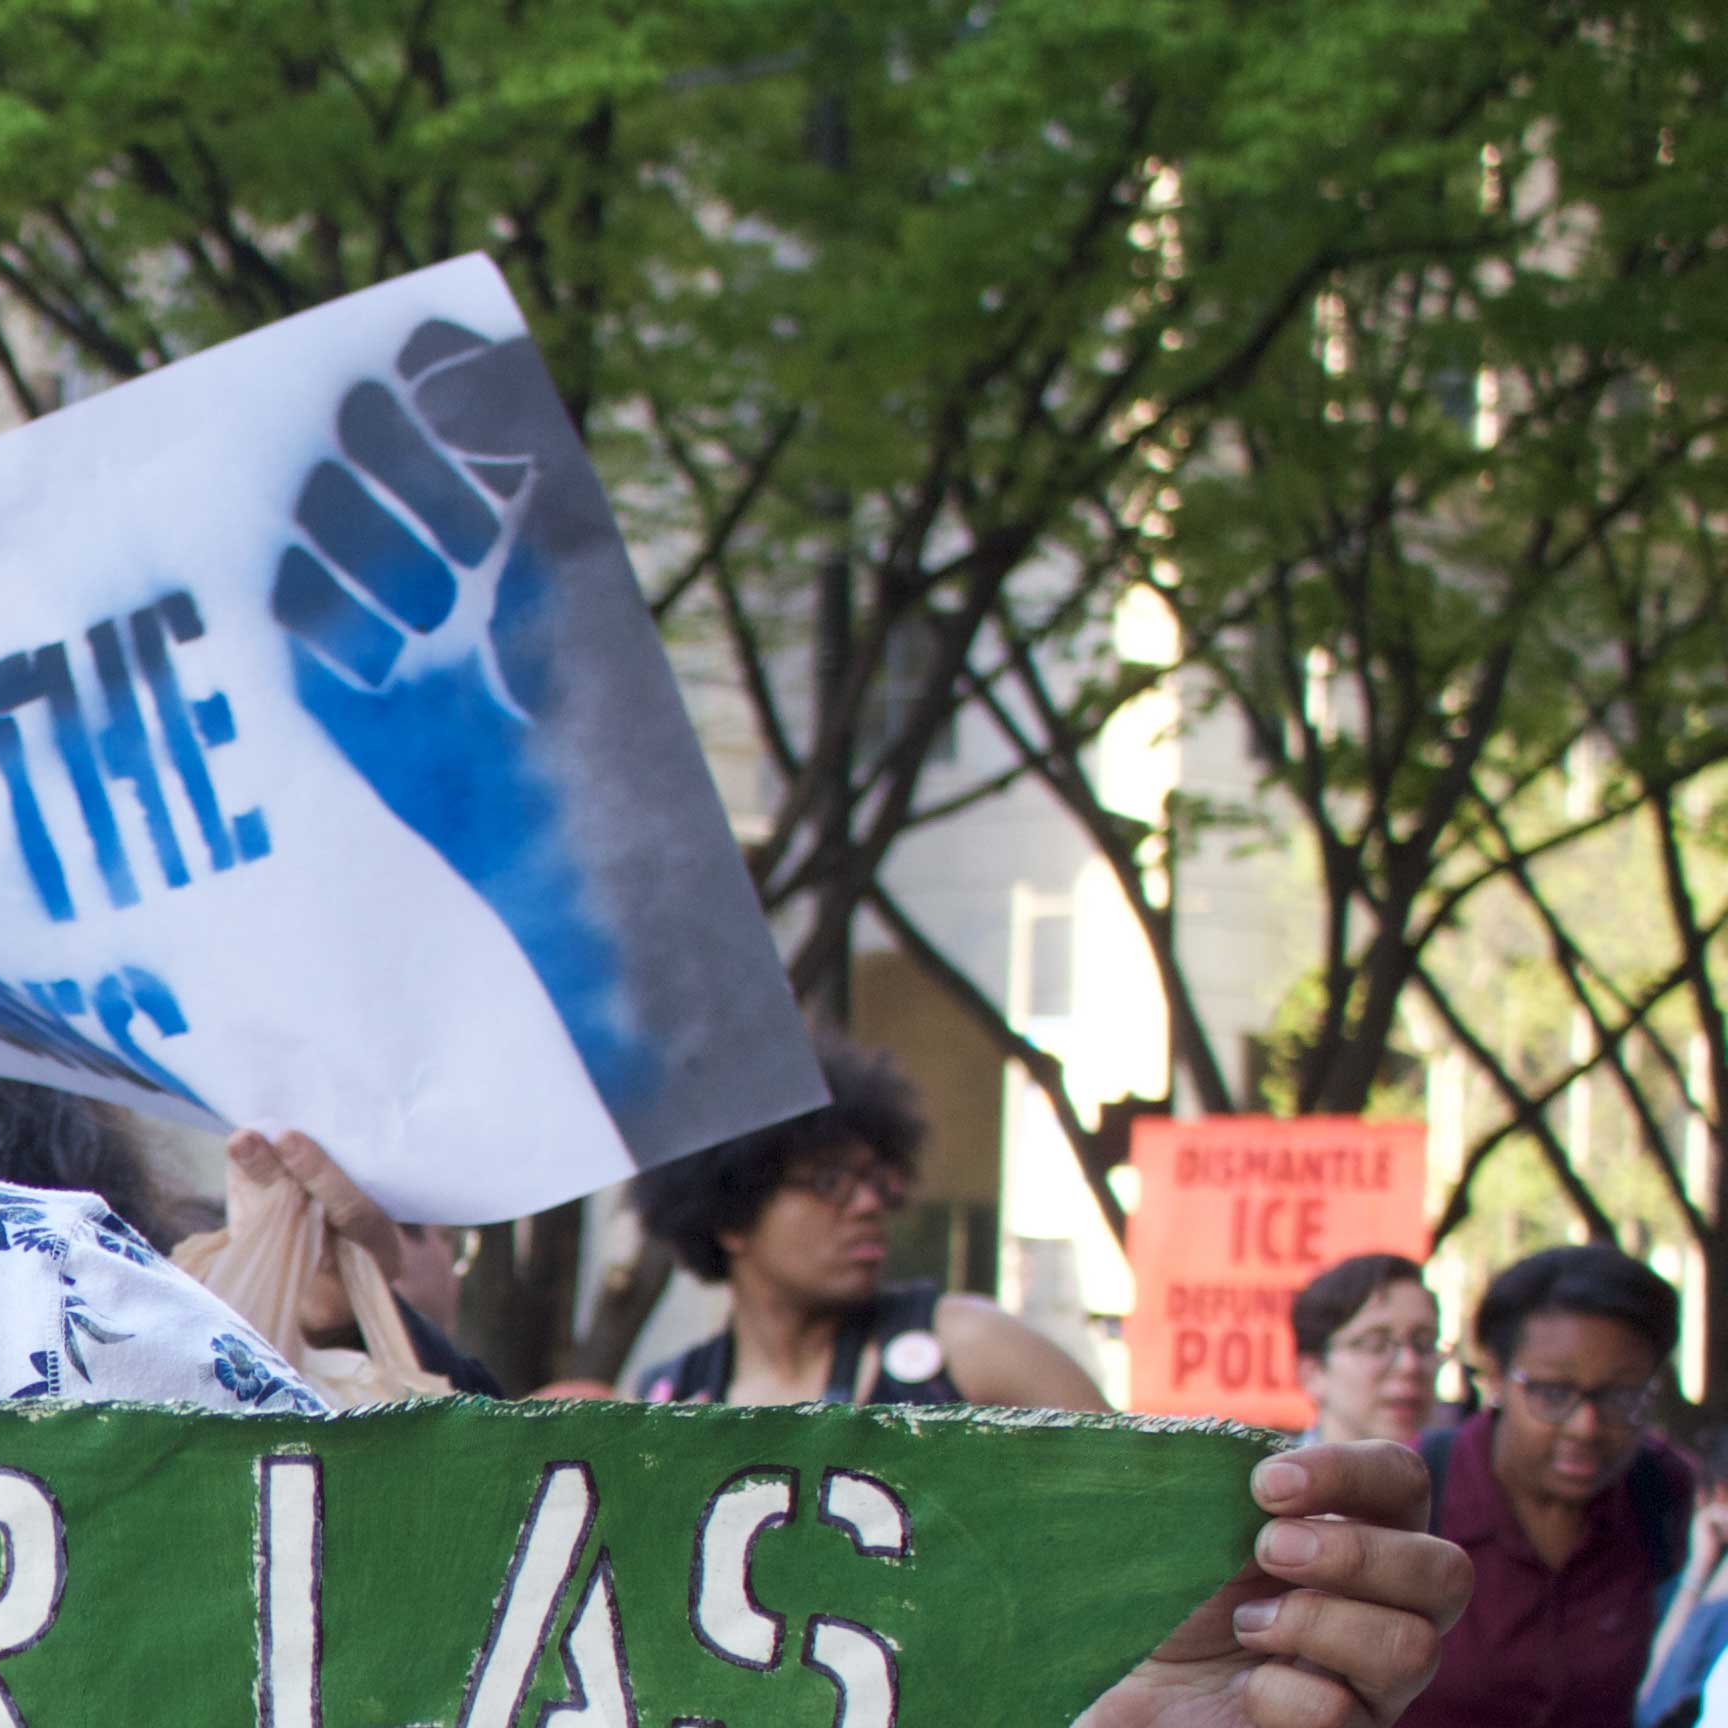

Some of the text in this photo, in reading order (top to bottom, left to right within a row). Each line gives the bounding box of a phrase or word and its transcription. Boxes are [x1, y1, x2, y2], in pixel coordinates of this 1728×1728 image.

[1176, 1146, 1390, 1190] DISMANTLE
[1231, 1197, 1327, 1262] ICE
[1171, 1330, 1286, 1391] POL
